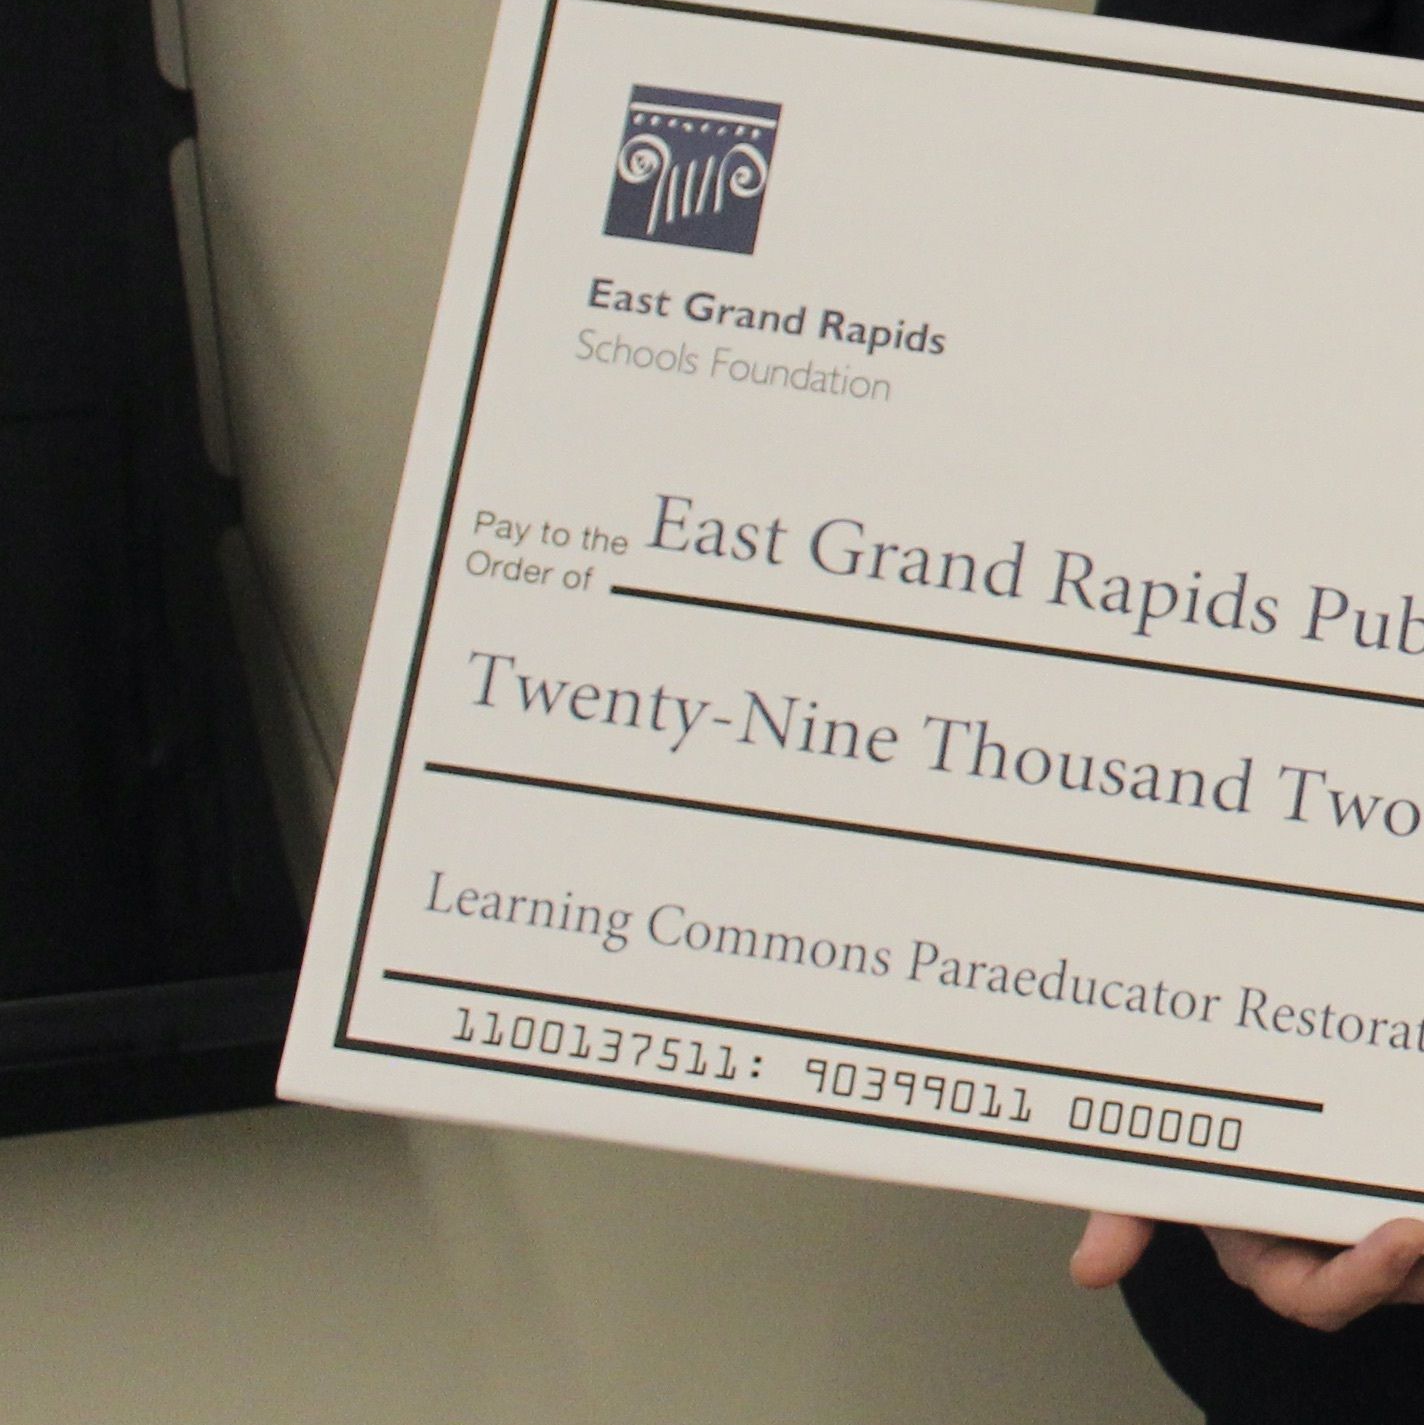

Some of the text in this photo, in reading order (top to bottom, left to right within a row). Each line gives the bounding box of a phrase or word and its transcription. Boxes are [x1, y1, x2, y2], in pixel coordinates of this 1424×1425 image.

[587, 277, 947, 357] East Grand Rapids
[576, 328, 891, 401] Schools Foundation
[465, 549, 595, 591] Order of
[473, 510, 629, 556] Pay to the
[645, 493, 788, 566] East
[809, 518, 1026, 599] Grand
[1045, 549, 1279, 638] Rapids
[468, 650, 899, 764] Twenty-Nine
[923, 714, 1254, 814] Thousand
[1278, 764, 1422, 838] Two
[425, 870, 634, 954] Learning
[647, 904, 891, 977] Commons
[906, 939, 1222, 1023] Paraeducator
[804, 1057, 1032, 1124] 90399011
[1068, 1095, 1243, 1153] 000000
